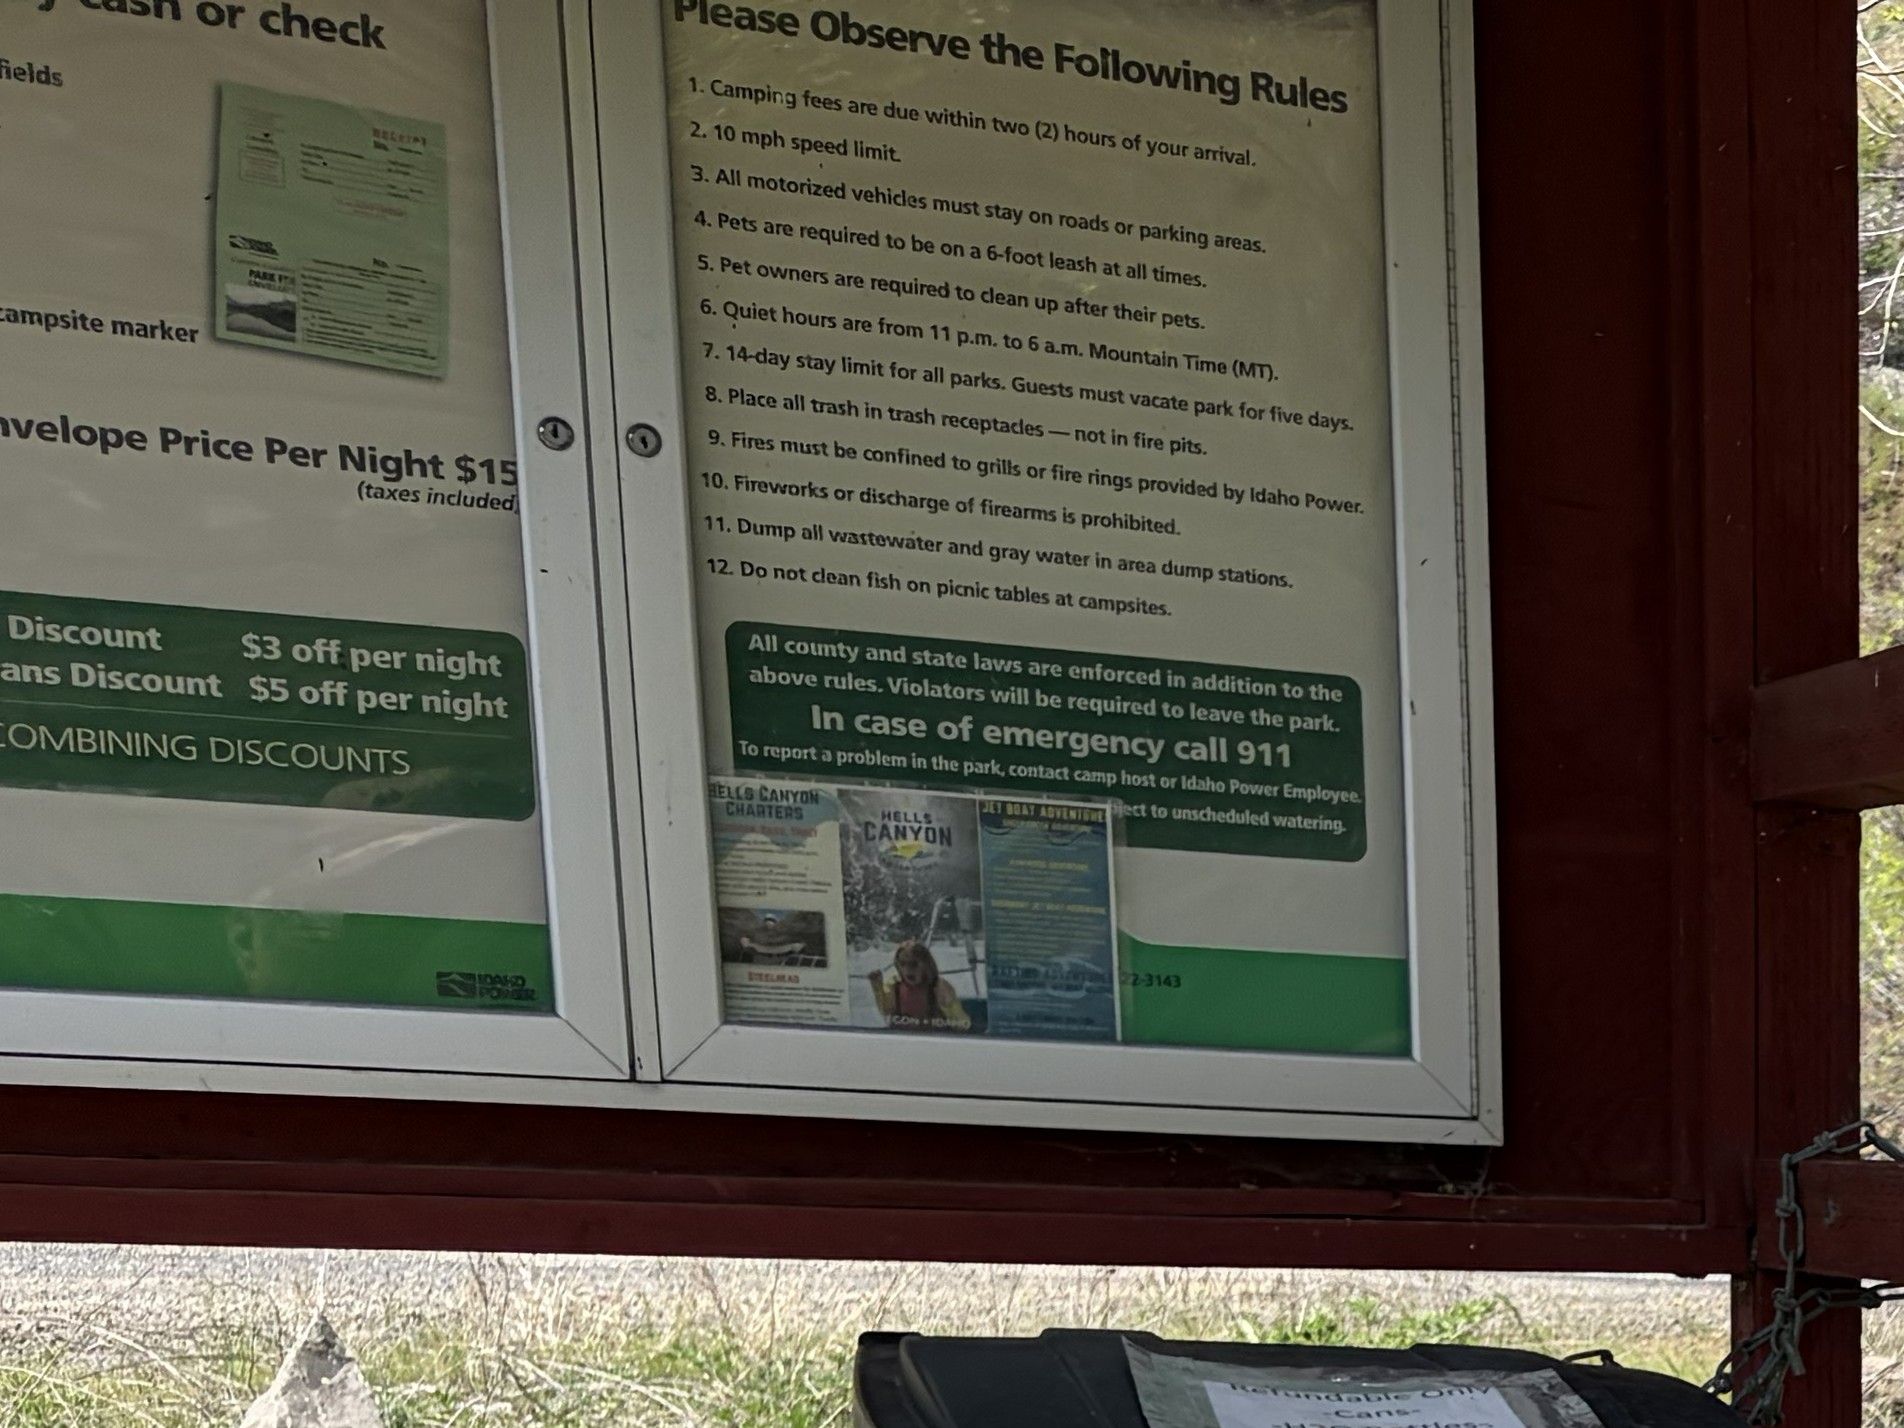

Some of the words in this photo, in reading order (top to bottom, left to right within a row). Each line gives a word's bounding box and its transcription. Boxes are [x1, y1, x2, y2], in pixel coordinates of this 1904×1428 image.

[196, 1, 246, 30] or
[259, 7, 387, 50] check
[674, 0, 801, 37] Please
[810, 9, 971, 60] Observe
[979, 32, 1045, 71] the
[1054, 42, 1241, 106] Following
[1250, 71, 1348, 114] Rules
[690, 120, 707, 139] 2.
[714, 124, 736, 142] 10
[741, 129, 785, 150] mph
[791, 137, 848, 157] speed
[694, 210, 712, 228] 4.
[718, 212, 758, 233] Pets
[763, 221, 794, 237] are
[800, 225, 880, 248] required
[885, 233, 906, 250] to
[911, 234, 935, 254] be
[940, 242, 965, 258] on
[970, 245, 982, 260] a
[986, 244, 1044, 268] 6-foot
[1049, 251, 1097, 274] leash
[1102, 262, 1121, 277] at
[1125, 262, 1147, 280] all
[1151, 265, 1207, 288] times.
[111, 319, 199, 344] marker
[159, 426, 254, 462] Price
[264, 436, 328, 469] Per
[338, 444, 445, 481] Night
[357, 482, 421, 503] (taxes
[7, 614, 163, 651] Discount
[241, 631, 282, 660] $3
[292, 637, 342, 665] off
[349, 647, 407, 673] per
[415, 647, 502, 681] night
[748, 633, 778, 652] All
[784, 640, 859, 664] county
[865, 645, 907, 663] and
[912, 649, 968, 669] state
[973, 652, 1023, 674] laws
[1028, 661, 1063, 678] are
[1068, 663, 1161, 686] enforced
[1167, 669, 1186, 689] in
[1191, 673, 1277, 697] addition
[1281, 682, 1304, 699] to
[1308, 683, 1343, 703] the
[70, 662, 223, 698] Discount
[249, 675, 290, 703] $5
[298, 680, 349, 707] off
[356, 689, 413, 715] per
[421, 689, 509, 722] night
[209, 736, 410, 775] DISCOUNTS
[811, 704, 845, 731] In
[854, 714, 928, 738] case
[937, 715, 974, 742] of
[982, 724, 1165, 764] emergency
[1174, 736, 1228, 763] call
[1237, 740, 1290, 768] 911
[864, 820, 953, 848] CANYON
[881, 809, 933, 825] HELLS
